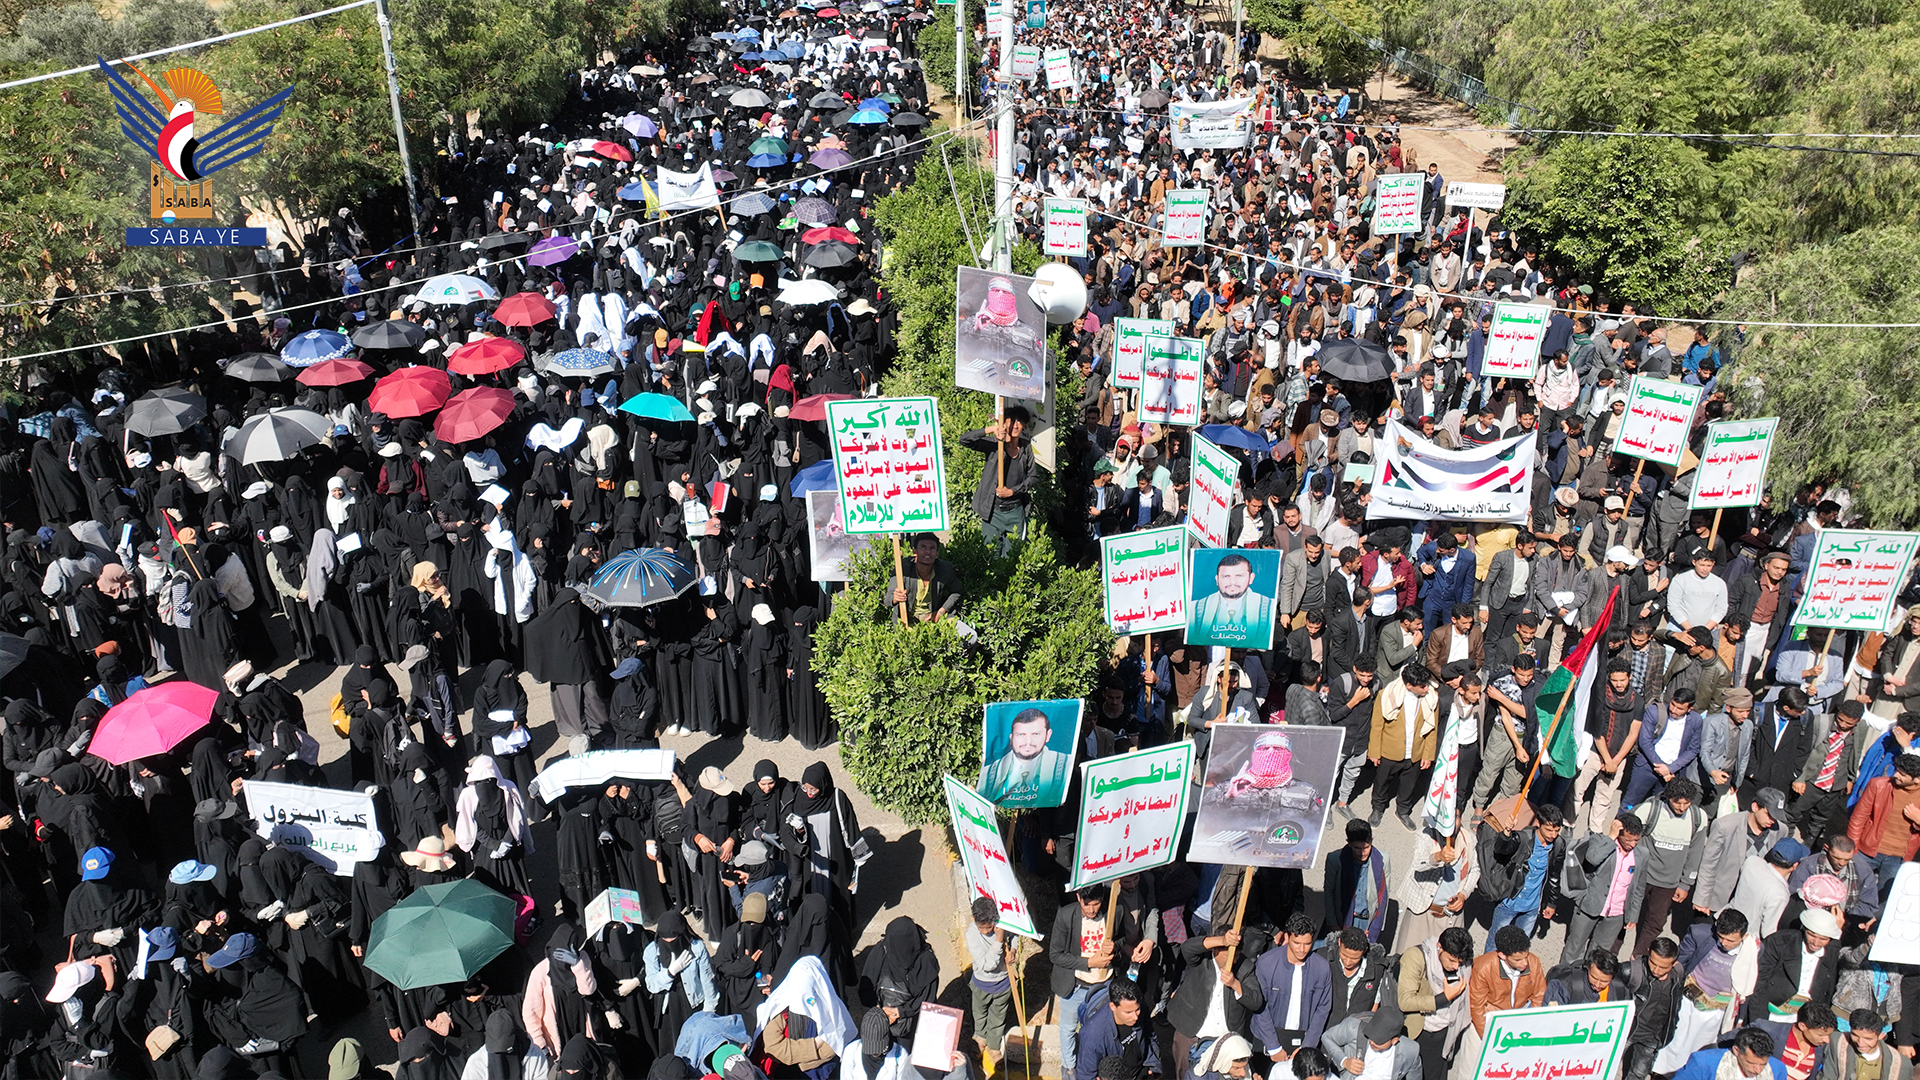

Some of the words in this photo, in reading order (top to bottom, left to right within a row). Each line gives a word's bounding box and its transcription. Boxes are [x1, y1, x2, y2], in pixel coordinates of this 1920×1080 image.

[1148, 343, 1199, 362] قاطعوا
[1174, 368, 1198, 383] البضائع
[1636, 384, 1694, 406] قاطعوا
[836, 402, 891, 436] أكبر
[895, 405, 930, 426] الله
[1660, 410, 1688, 424] البضائع
[1711, 426, 1770, 448] قاطعوا
[894, 457, 934, 475] الموت
[1736, 450, 1764, 465] البضائع
[846, 483, 879, 500] اليهود
[883, 483, 902, 499] على
[906, 480, 936, 494] اللعنة
[898, 500, 938, 526] النصر
[1488, 502, 1512, 516] كلية
[1110, 536, 1180, 566] قاطعوا
[1822, 536, 1878, 556] أكبر
[1875, 539, 1910, 554] الله
[1148, 562, 1180, 582] البضائع
[1864, 561, 1902, 572] الموت
[1858, 577, 1895, 588] الموت
[1144, 588, 1148, 600] و
[1839, 592, 1857, 604] على
[1860, 590, 1890, 602] اللعنة
[1800, 606, 1844, 624] للإسلام
[1844, 606, 1884, 624] النصر
[1240, 624, 1247, 632] يا
[1090, 758, 1182, 800] قاطعوا
[1134, 793, 1178, 816] البضائع
[263, 804, 326, 826] البترول
[1124, 823, 1130, 840] و
[310, 838, 328, 850] رام
[1492, 1019, 1615, 1054] قاطعوا
[1546, 1058, 1604, 1080] البضائع
